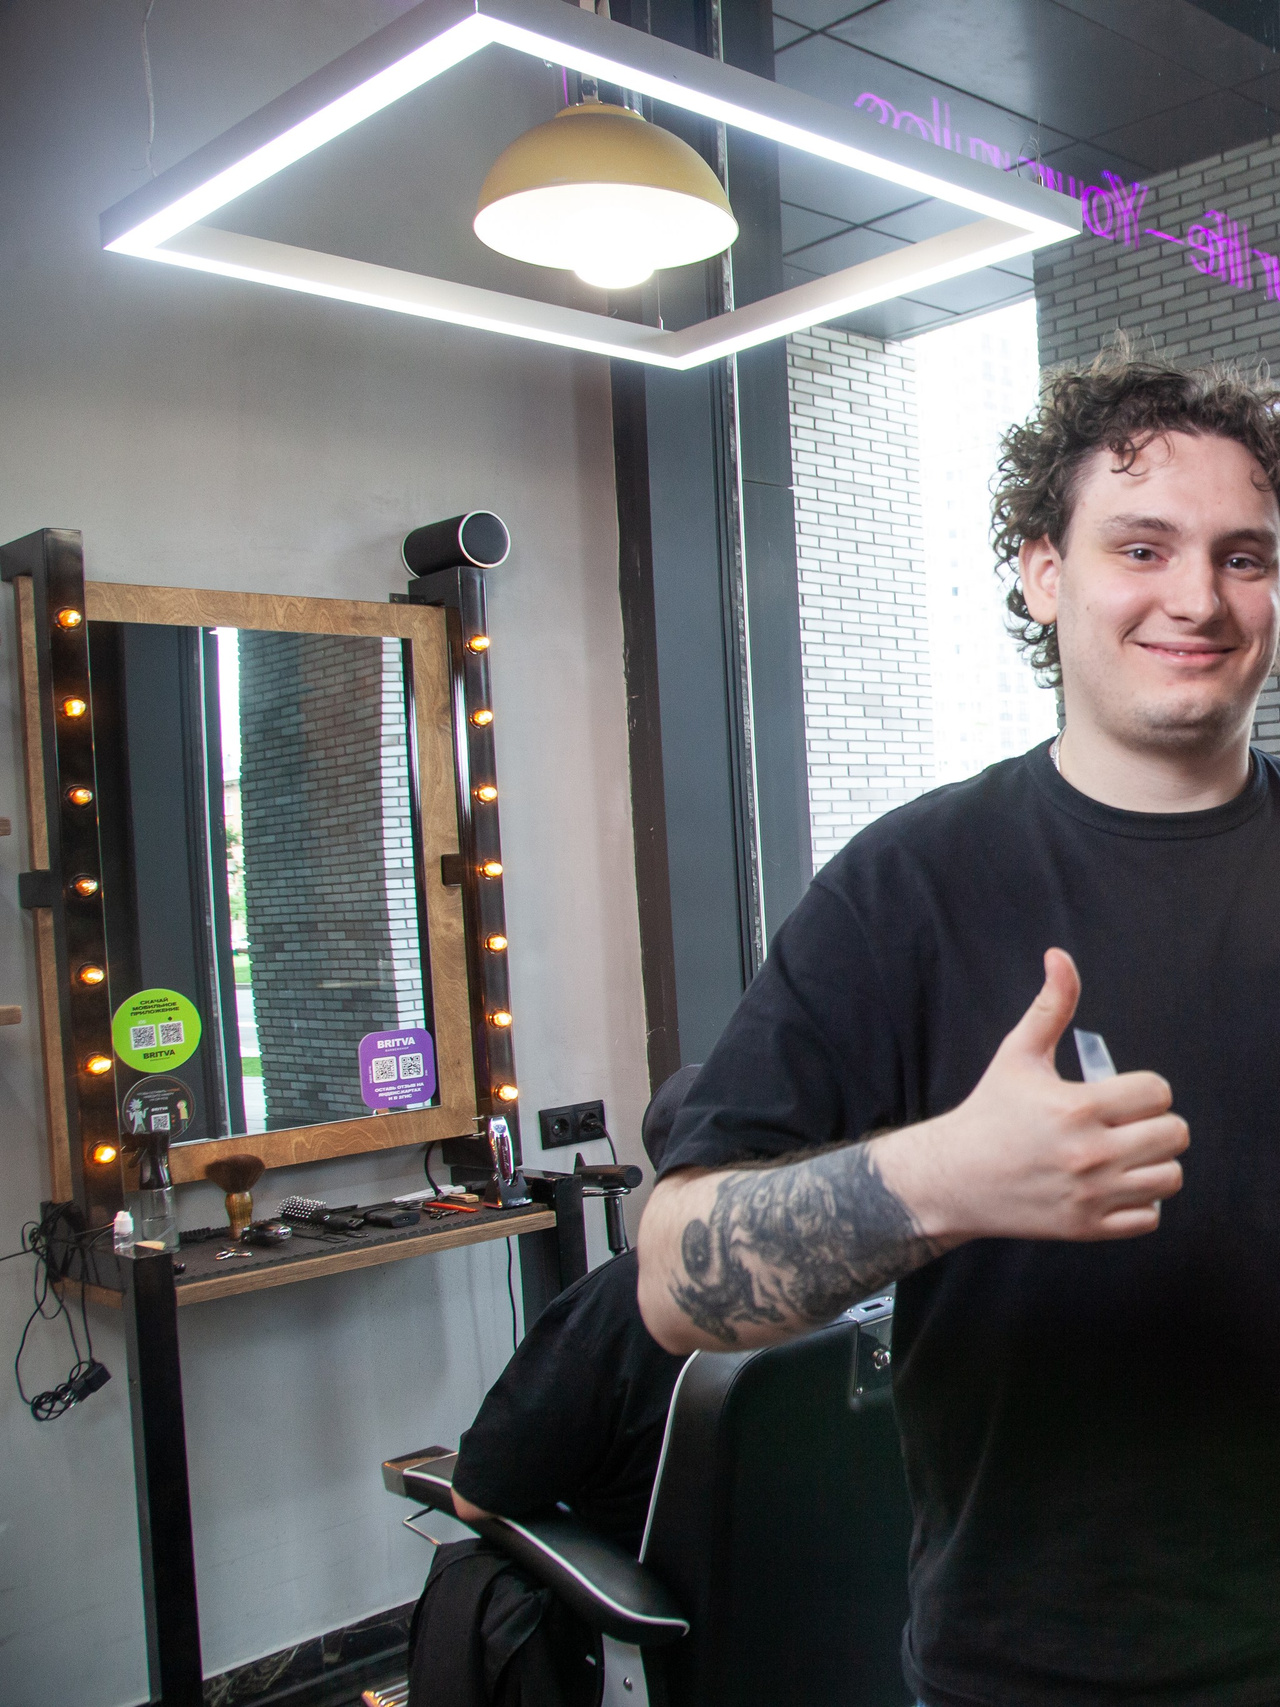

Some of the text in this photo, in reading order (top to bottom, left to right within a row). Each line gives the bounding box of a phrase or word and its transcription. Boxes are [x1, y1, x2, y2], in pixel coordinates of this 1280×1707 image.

[132, 1002, 177, 1011] МОБИЛЬНОЕ
[130, 1007, 180, 1016] ПРИЛОЖЕНИЕ
[377, 1037, 416, 1049] BRITVA
[143, 1049, 176, 1059] BRITVA
